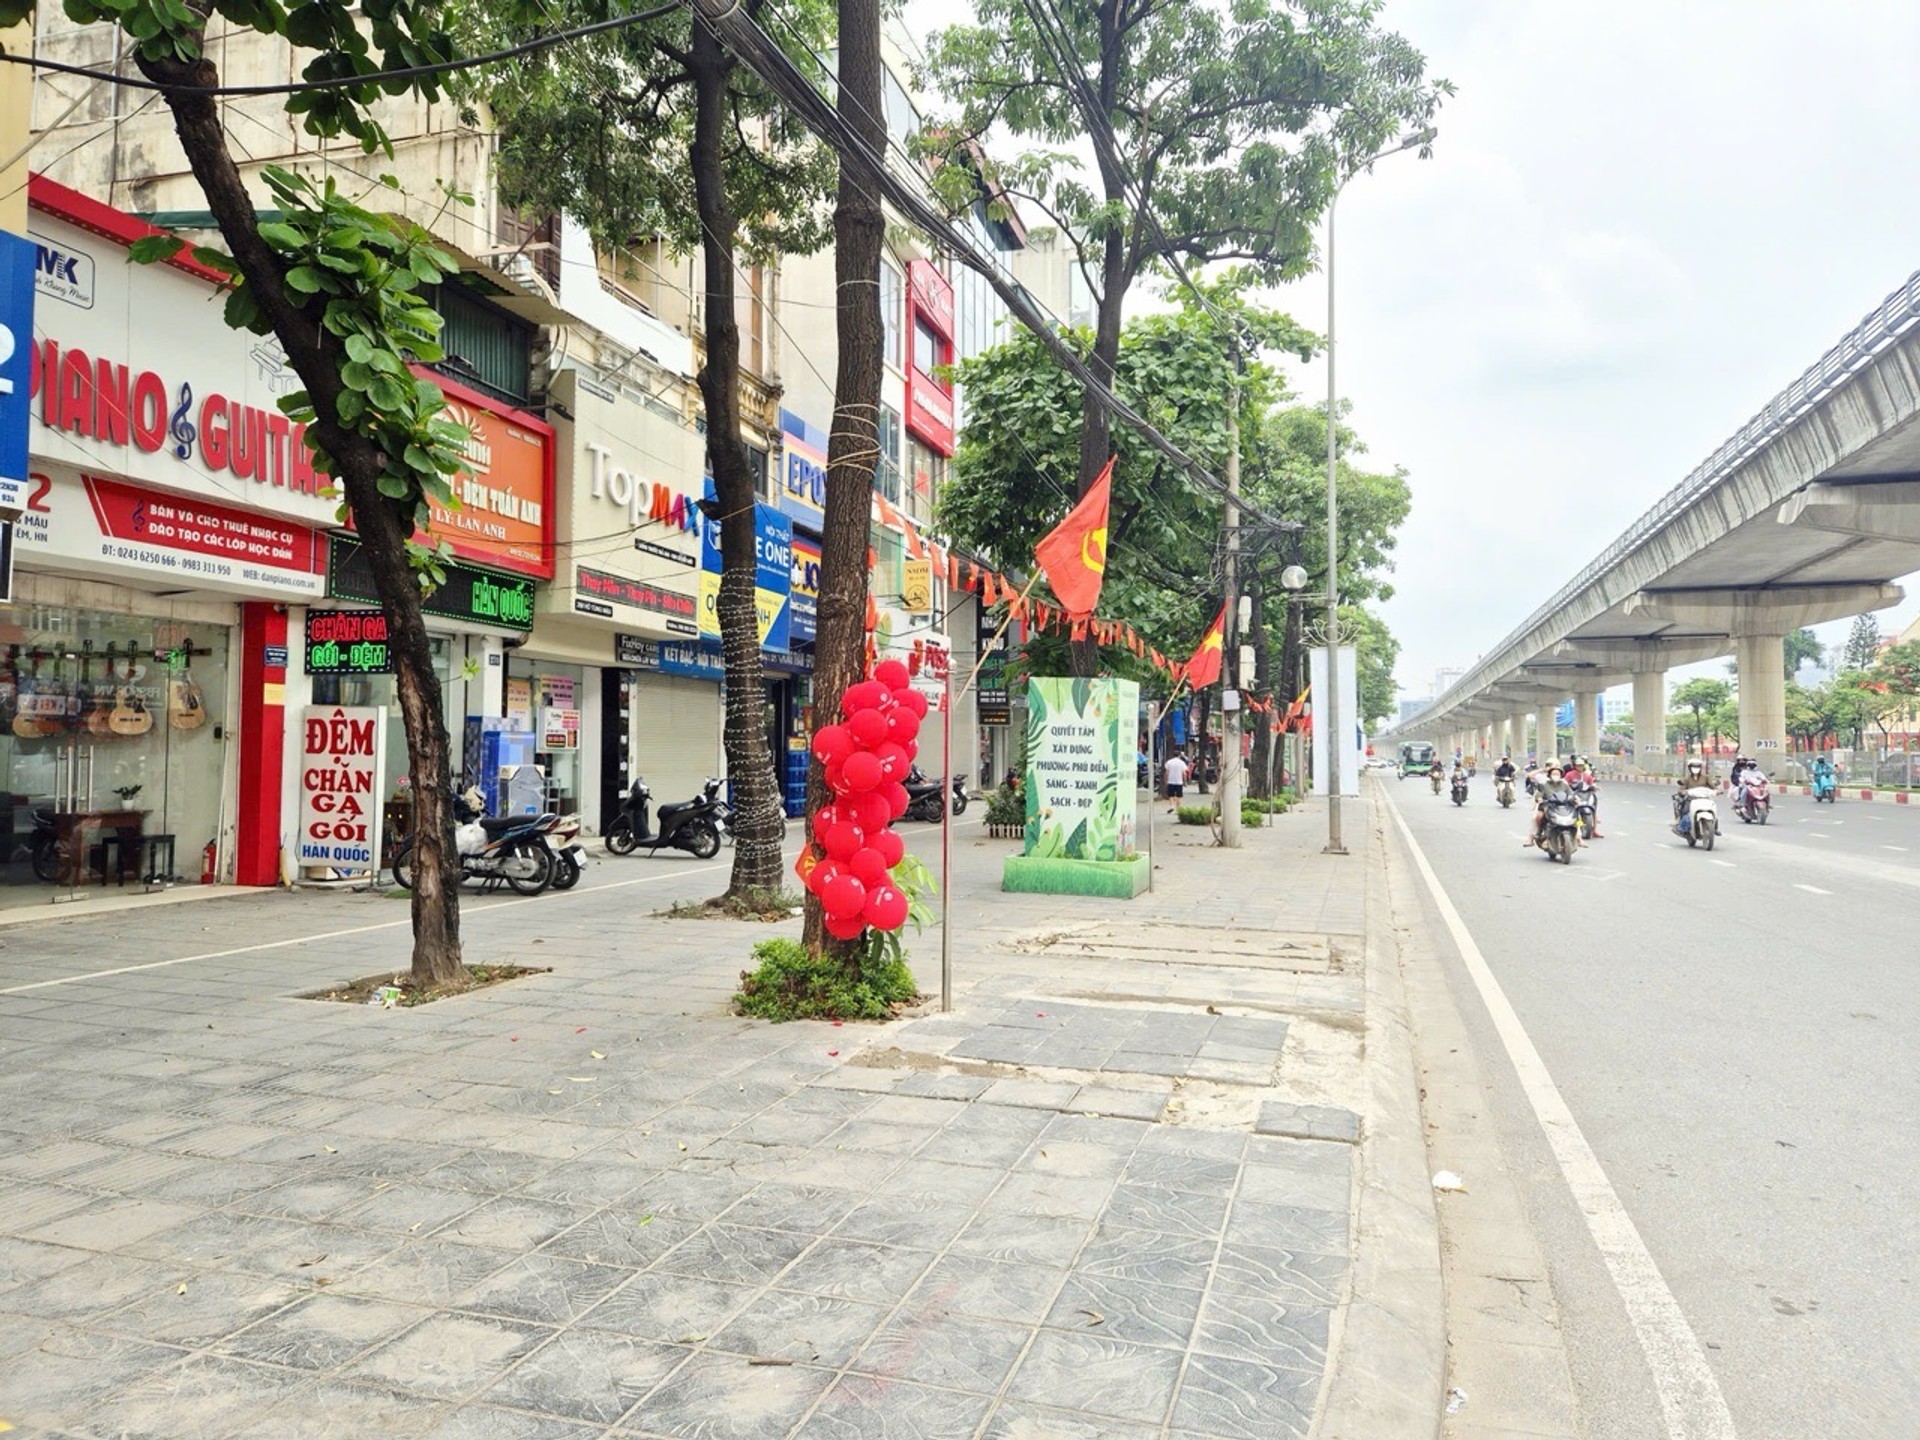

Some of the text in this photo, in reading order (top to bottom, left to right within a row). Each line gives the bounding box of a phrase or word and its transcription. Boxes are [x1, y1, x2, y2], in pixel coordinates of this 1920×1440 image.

[199, 393, 337, 499] GUITA
[457, 514, 480, 532] LAN
[482, 520, 506, 539] ANH
[117, 547, 138, 561] 0243
[140, 550, 160, 564] 6250
[162, 554, 176, 567] 666
[182, 559, 201, 571] 0983
[305, 708, 375, 765] ĐỆM
[1051, 724, 1075, 737] QUYẾT
[304, 762, 373, 794] CHĂN
[1075, 780, 1098, 790] XANH
[311, 793, 363, 815] GA
[309, 815, 367, 842] GỐI
[302, 842, 370, 861] HÀN QUỐC
